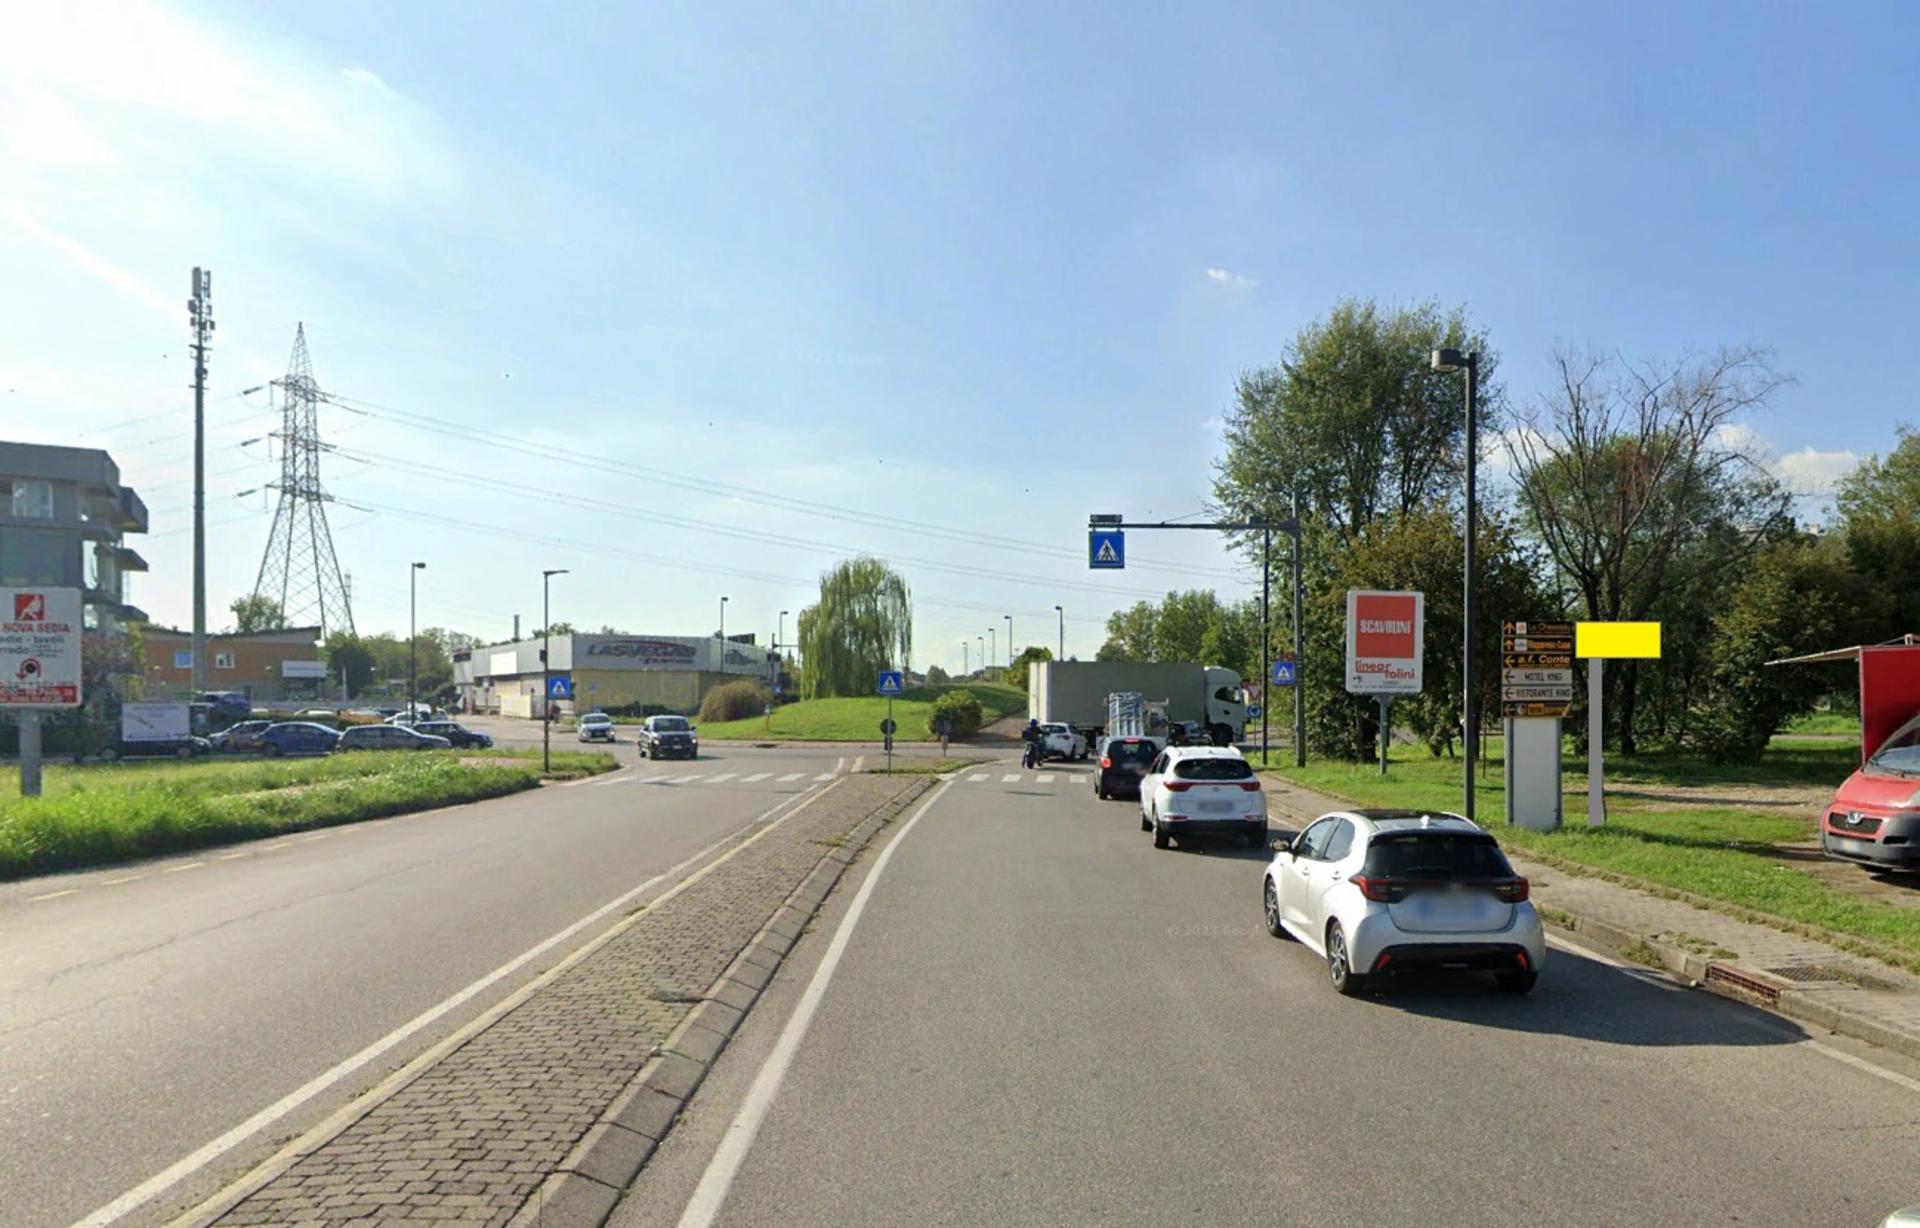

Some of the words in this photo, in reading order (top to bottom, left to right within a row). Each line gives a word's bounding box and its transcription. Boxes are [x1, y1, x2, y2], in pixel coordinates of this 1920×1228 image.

[37, 623, 70, 633] SEDIA
[1360, 619, 1411, 633] SCAVOLINI
[1538, 655, 1570, 664] Conte
